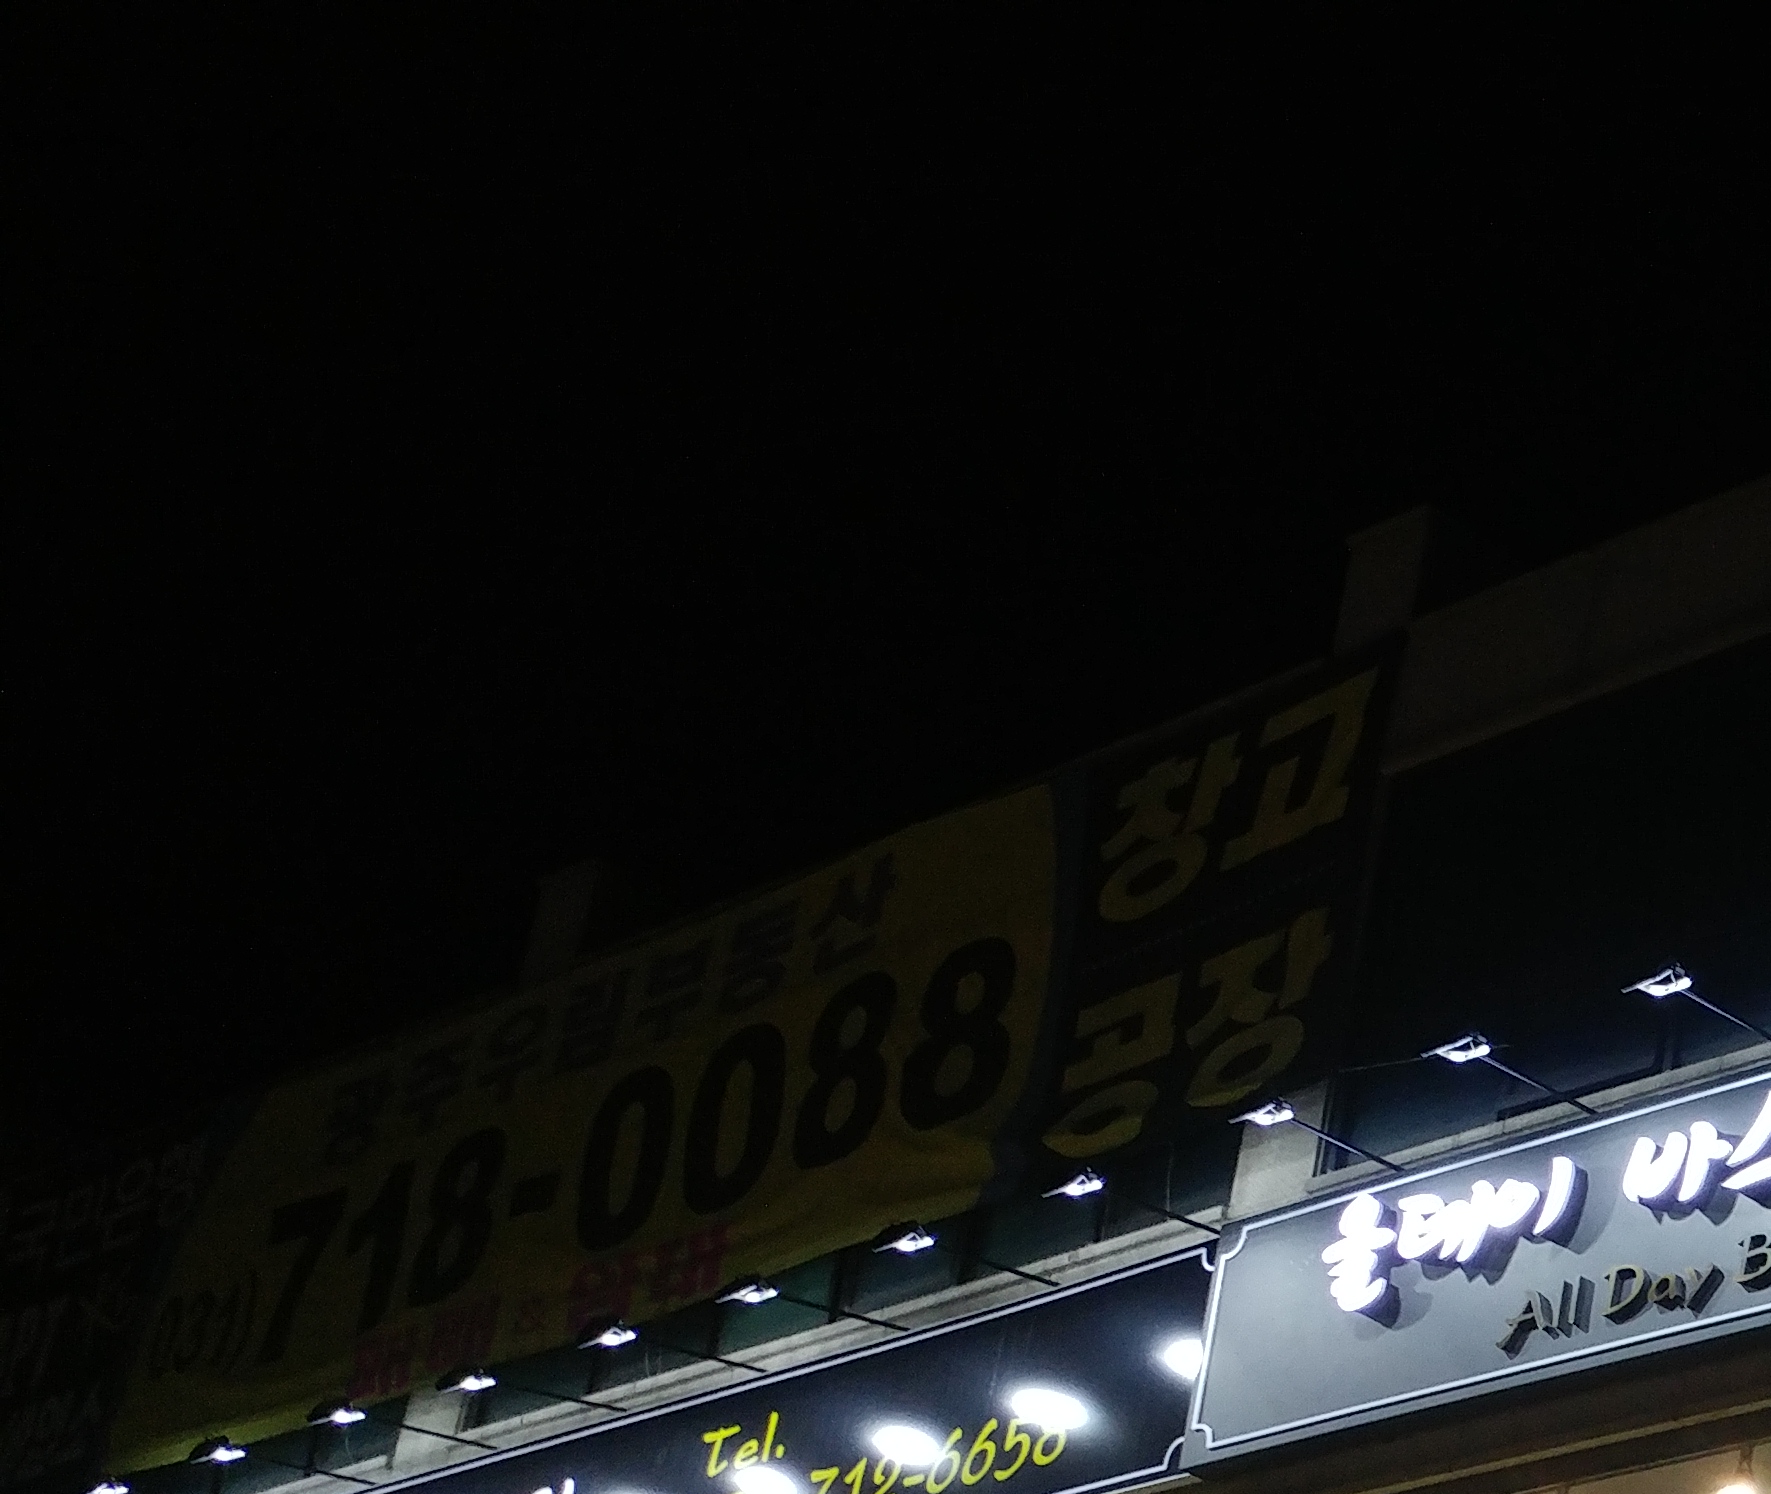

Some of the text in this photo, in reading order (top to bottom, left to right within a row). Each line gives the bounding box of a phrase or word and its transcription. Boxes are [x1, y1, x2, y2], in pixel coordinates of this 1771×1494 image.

[1503, 1275, 1588, 1337] All
[1602, 1263, 1718, 1320] Day
[703, 1410, 785, 1478] Tel.
